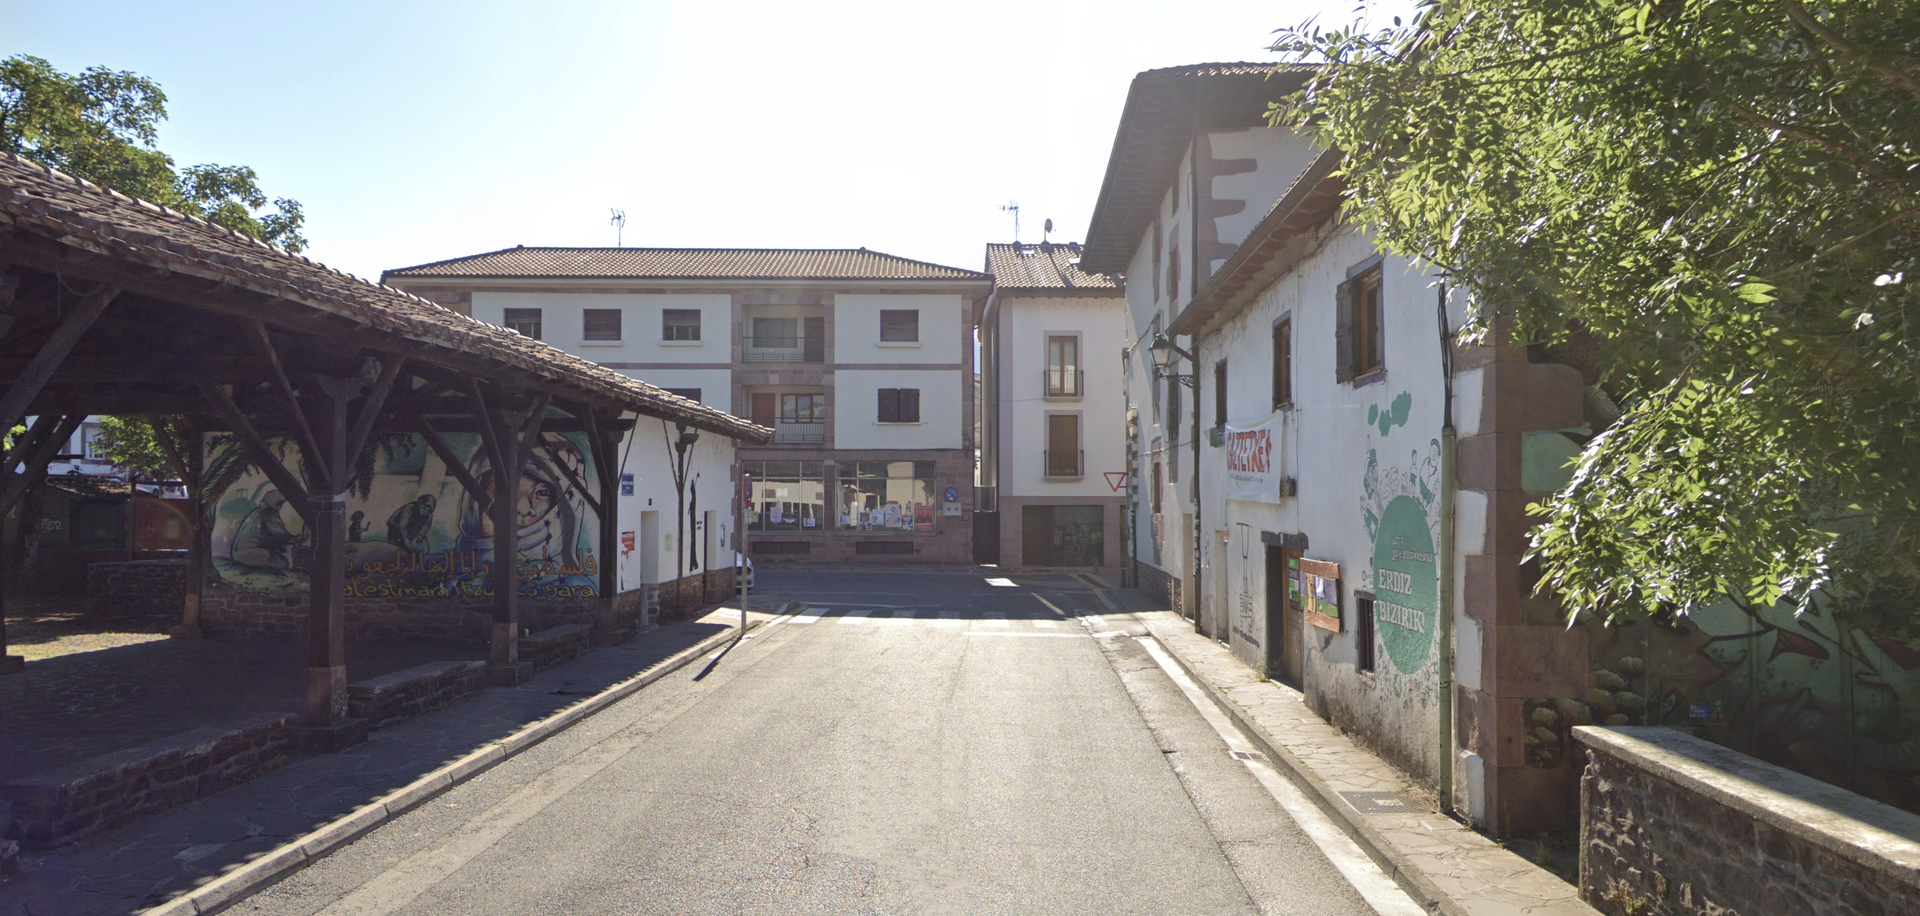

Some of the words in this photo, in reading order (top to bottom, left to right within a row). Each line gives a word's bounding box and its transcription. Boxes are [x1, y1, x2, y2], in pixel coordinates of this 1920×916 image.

[344, 578, 450, 598] alestinara
[543, 584, 596, 599] gara
[1378, 568, 1413, 596] ERDIZ
[1378, 600, 1425, 635] BIZIRIK!
